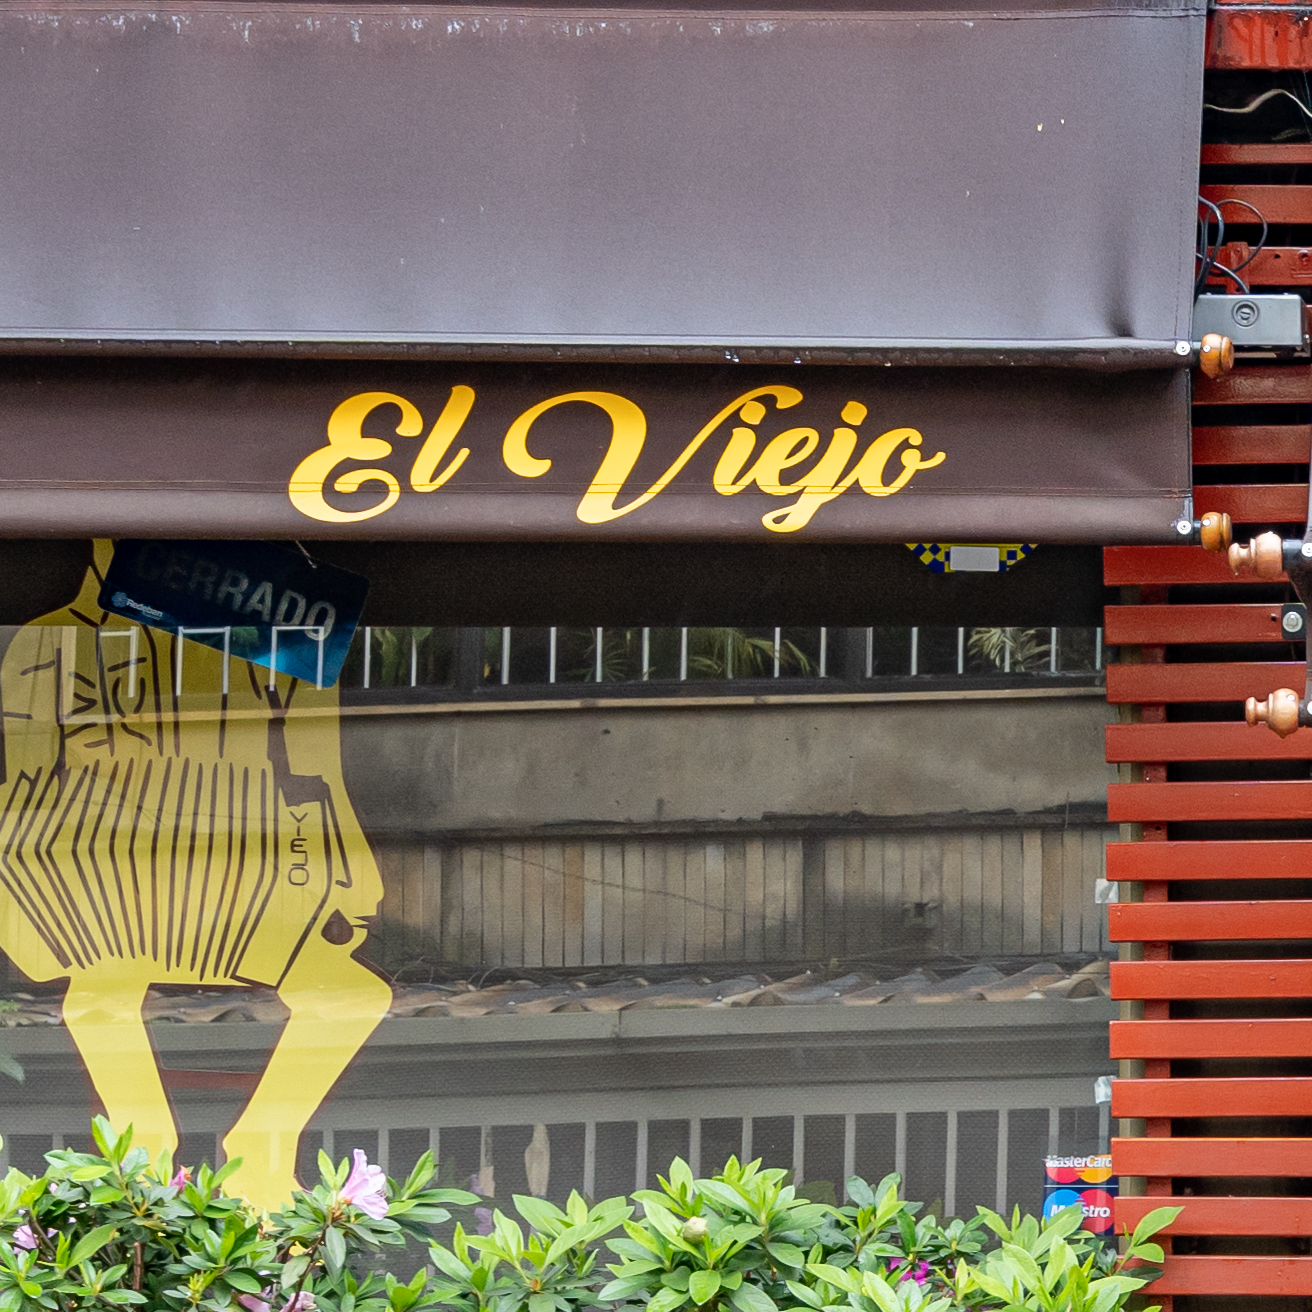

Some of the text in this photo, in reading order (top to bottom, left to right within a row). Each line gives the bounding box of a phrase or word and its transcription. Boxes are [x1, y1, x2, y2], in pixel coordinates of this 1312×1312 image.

[288, 385, 946, 533] El Viejo
[135, 541, 337, 641] CERRADO
[288, 811, 309, 886] VIEJO
[1050, 1204, 1110, 1218] Mstro
